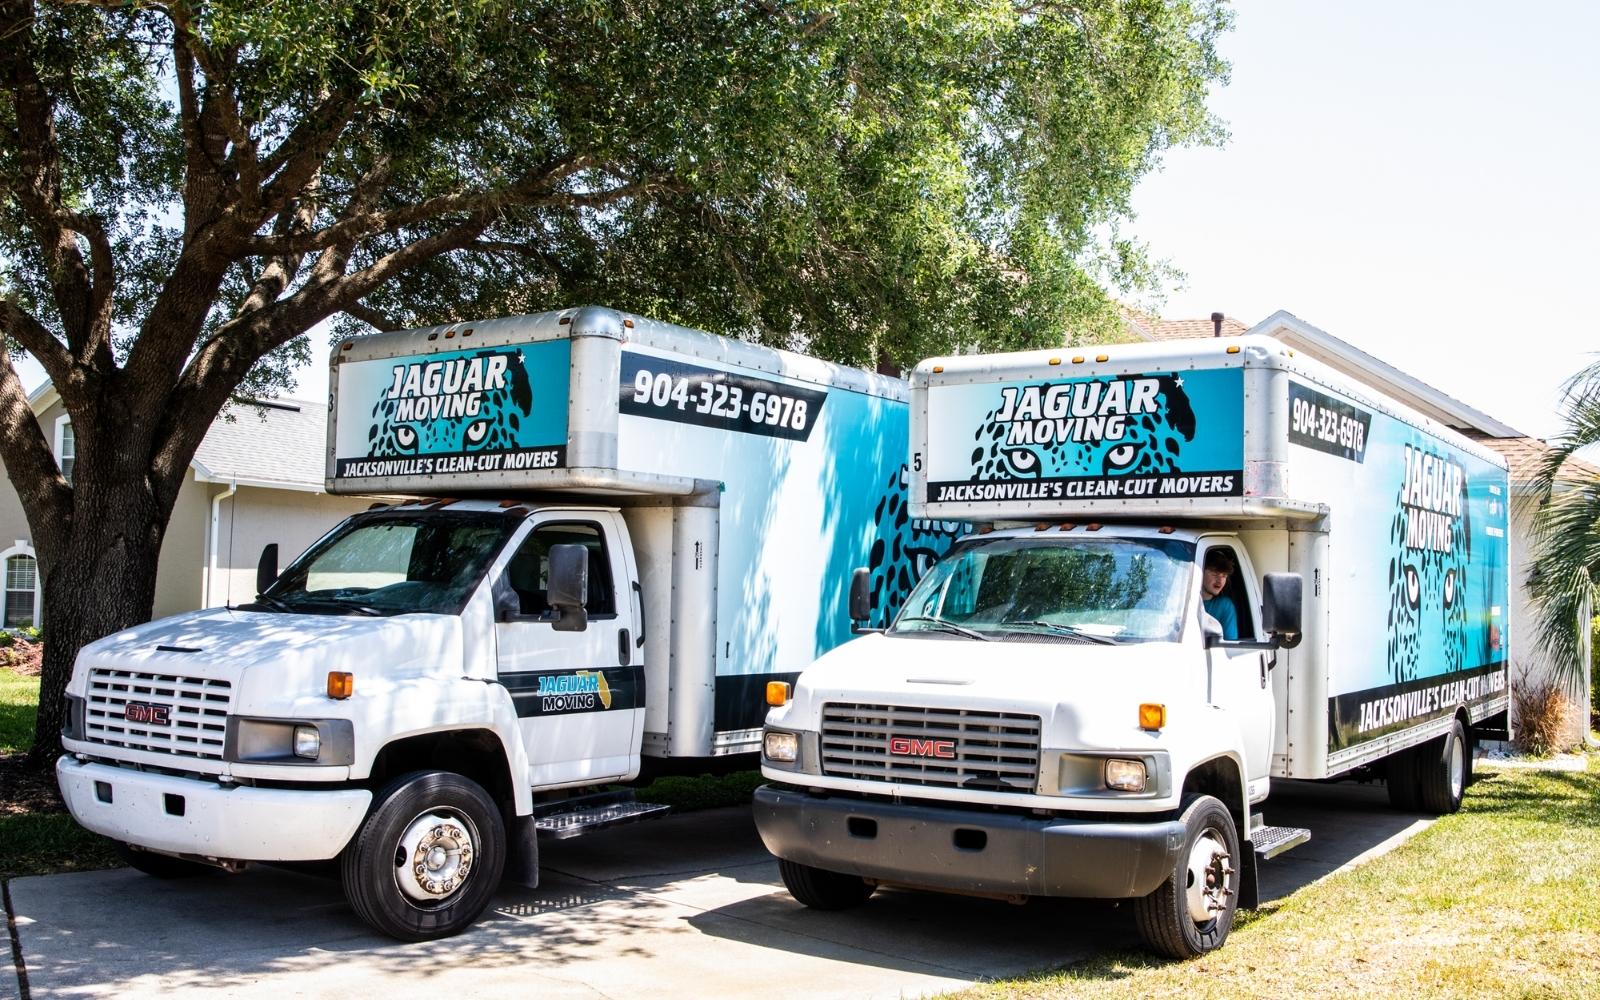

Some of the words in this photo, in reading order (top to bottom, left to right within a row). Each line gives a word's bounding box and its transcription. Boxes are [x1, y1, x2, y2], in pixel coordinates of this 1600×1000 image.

[387, 355, 508, 399] JAGUAR
[394, 392, 481, 422] MOVING
[633, 369, 807, 431] 904-323-6978
[995, 378, 1160, 422] JAGUAR
[1006, 415, 1125, 446] MOVING
[1293, 397, 1364, 452] 904-323-6978
[343, 458, 433, 477] JACKSONVILLE'S
[435, 453, 502, 473] CLEAN-CUT
[503, 451, 559, 469] MOVERS
[914, 453, 922, 472] 5
[937, 483, 1062, 501] JACKSONVILLE'S
[1066, 479, 1155, 497] CLEAN-CUT
[1158, 475, 1234, 493] MOVERS
[1401, 445, 1462, 516] JAGUAR
[1406, 508, 1451, 553] MOVING
[537, 675, 600, 696] JAGUAR
[125, 704, 167, 725] GMC
[543, 694, 595, 711] MOVING
[1358, 686, 1440, 733] JACKSONVILLE'S
[1440, 675, 1481, 708] CLEAN-CUT
[1480, 669, 1505, 696] MOVERS
[890, 737, 955, 758] GMC
